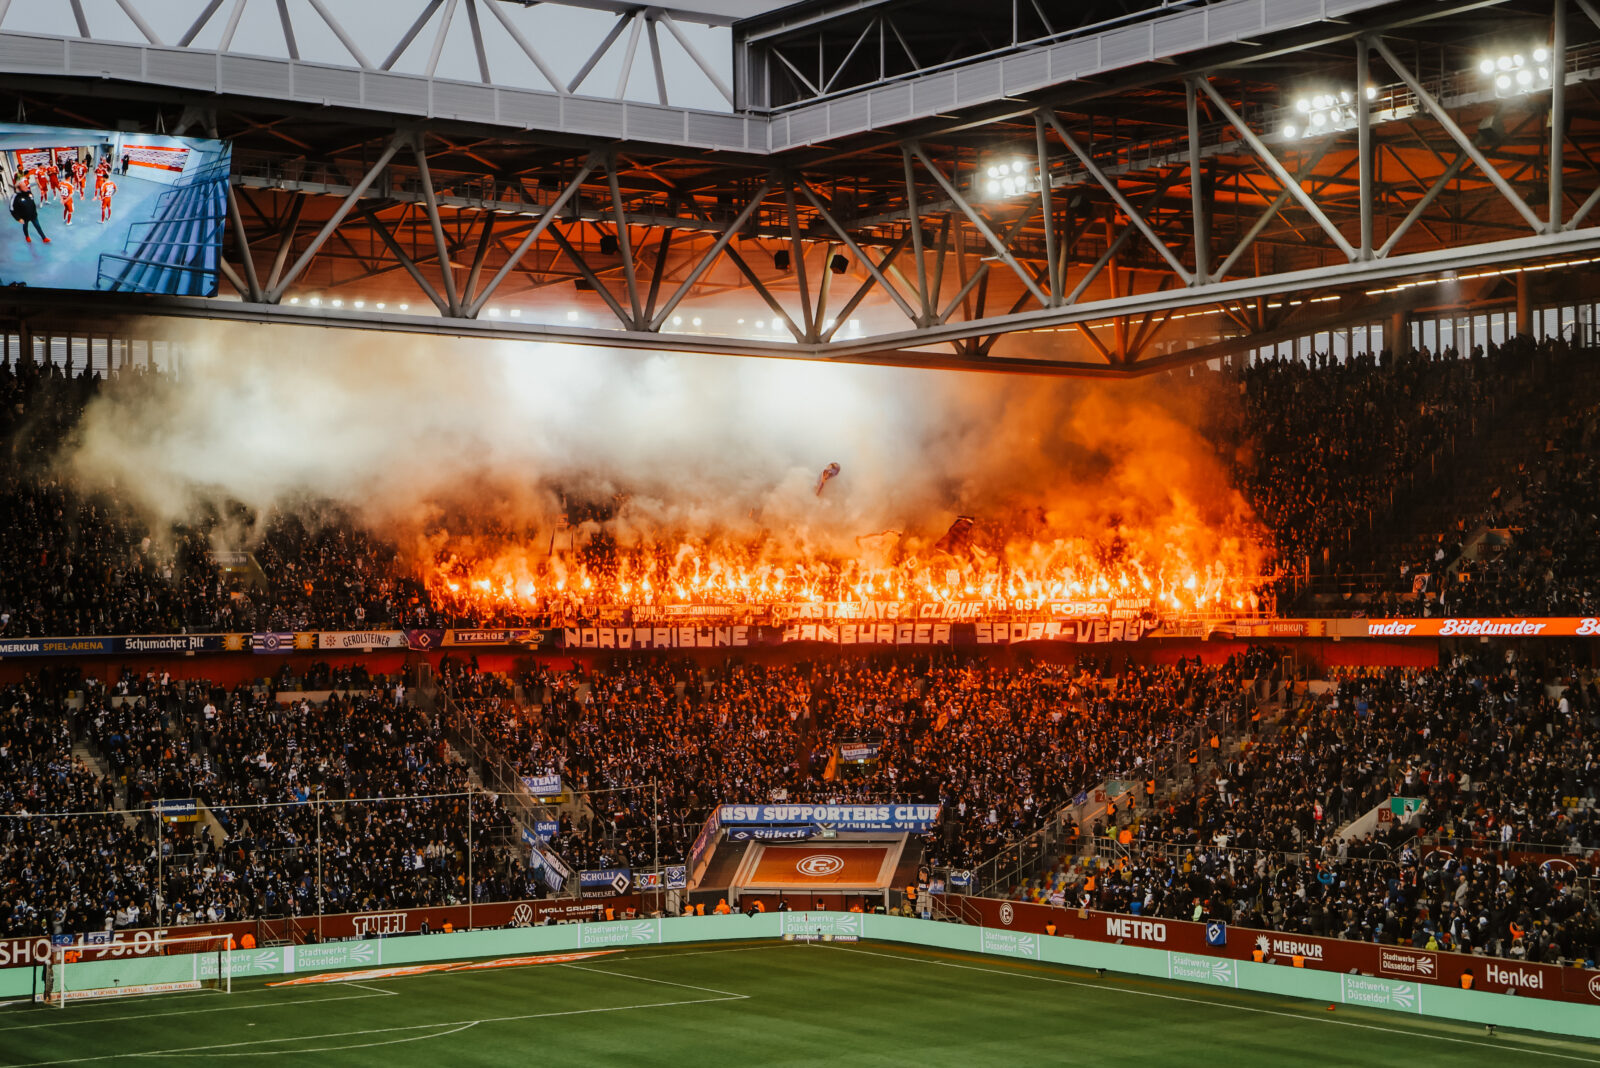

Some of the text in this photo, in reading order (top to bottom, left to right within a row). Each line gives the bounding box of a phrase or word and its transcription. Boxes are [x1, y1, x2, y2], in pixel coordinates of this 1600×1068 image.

[1051, 603, 1108, 615] FORZA
[1272, 623, 1304, 633] MERKUR
[1439, 619, 1547, 636] Böklunder
[343, 633, 391, 647] GEROLSTEINER
[458, 631, 505, 641] ITZEHOE
[564, 625, 749, 649] NORDTRIBÜNE
[782, 623, 952, 645] HAMBURGER
[0, 641, 104, 653] MERKUR SPIEL-ARENA
[125, 636, 204, 651] Schumacher Alt
[532, 776, 558, 786] TEAM
[721, 806, 758, 821] HSV
[764, 806, 890, 821] SUPPORTERS
[1381, 810, 1390, 821] 23
[580, 872, 615, 882] SCHOLLI
[566, 904, 604, 913] GRUPPE
[352, 913, 407, 936] TUFFI
[787, 914, 834, 923] Stadtwerke
[584, 924, 629, 935] Stadtwerke
[787, 922, 835, 933] Düsseldorf
[1106, 917, 1167, 943] METRO
[584, 933, 629, 944] Düsseldorf
[985, 931, 1017, 943] Stadtwerke
[299, 946, 347, 958] Stadtwerke
[985, 940, 1018, 952] Düsseldorf
[1273, 939, 1324, 958] MERKUR
[298, 956, 348, 968] Düsseldorf
[1173, 955, 1210, 969] Stadtwerke
[1382, 951, 1416, 963] Stadtwerke
[1382, 960, 1416, 972] Düsseldorf
[1173, 965, 1211, 980] Düsseldorf
[1486, 963, 1544, 989] Henkel
[1347, 978, 1390, 993] Stadtwerke
[1347, 989, 1390, 1003] Düsseldorf
